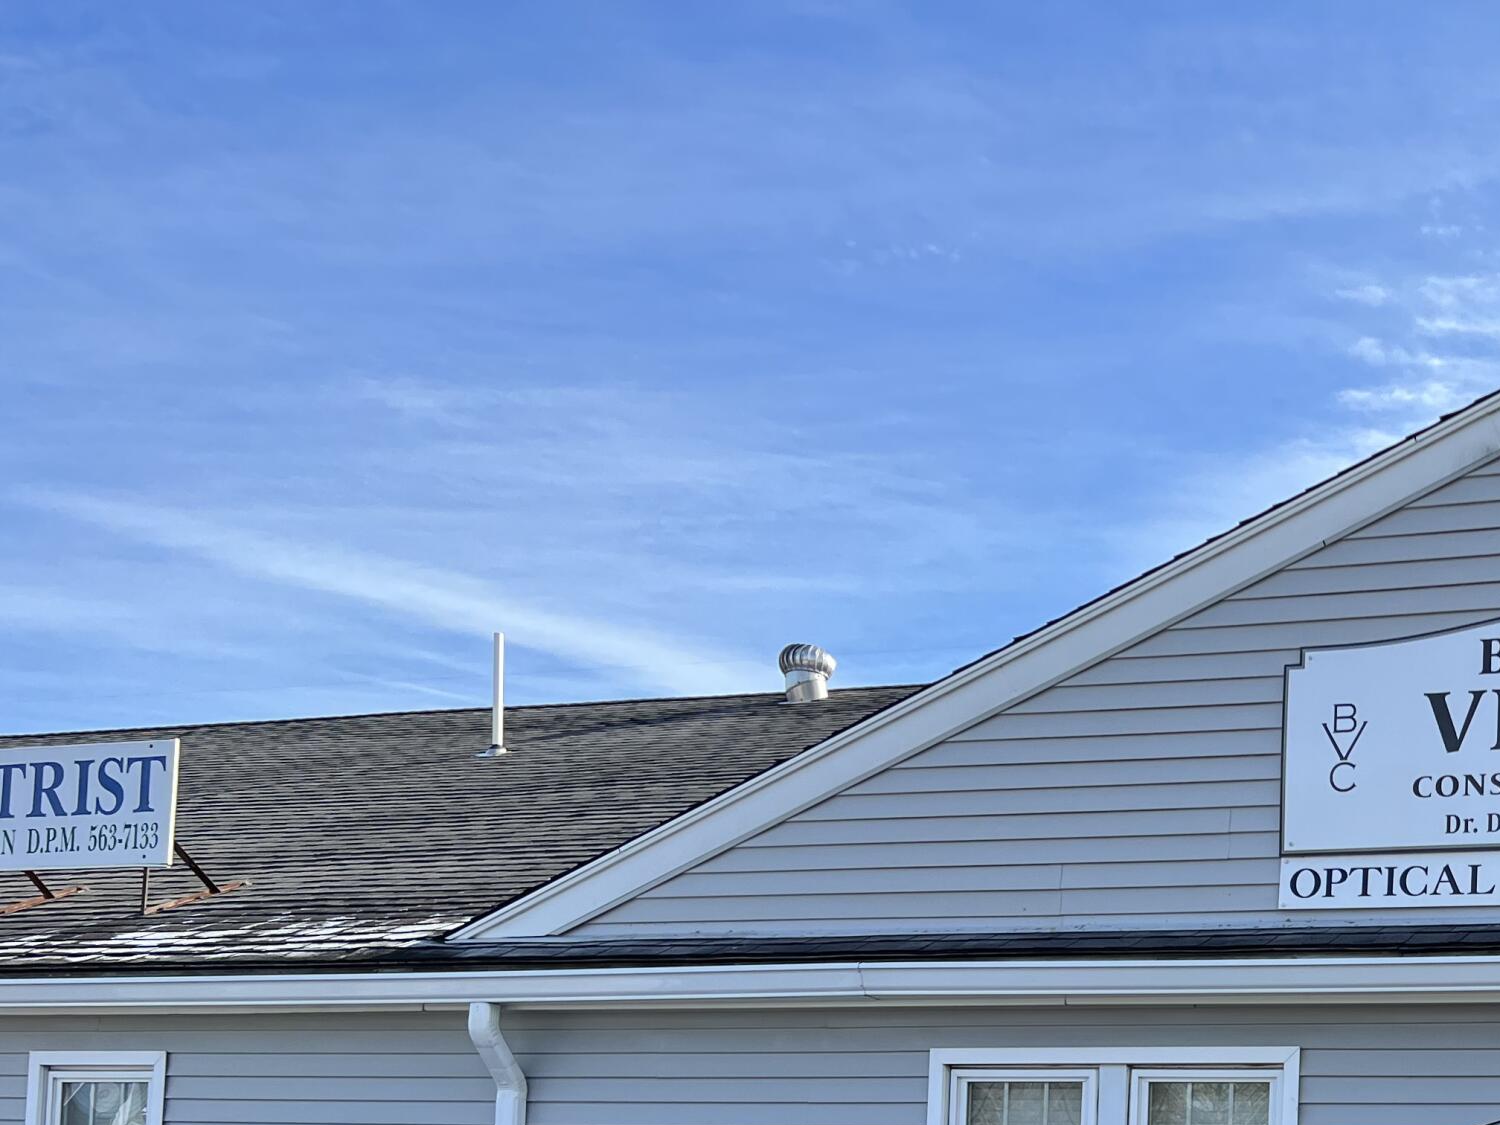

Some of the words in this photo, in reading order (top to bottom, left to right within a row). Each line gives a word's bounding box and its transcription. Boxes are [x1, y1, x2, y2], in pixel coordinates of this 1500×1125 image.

[0, 756, 167, 819] TRIST
[26, 826, 80, 854] D.P.M.
[87, 822, 159, 852] 563-7133
[1444, 814, 1479, 834] Dr.
[1289, 864, 1496, 900] OPTICAL
